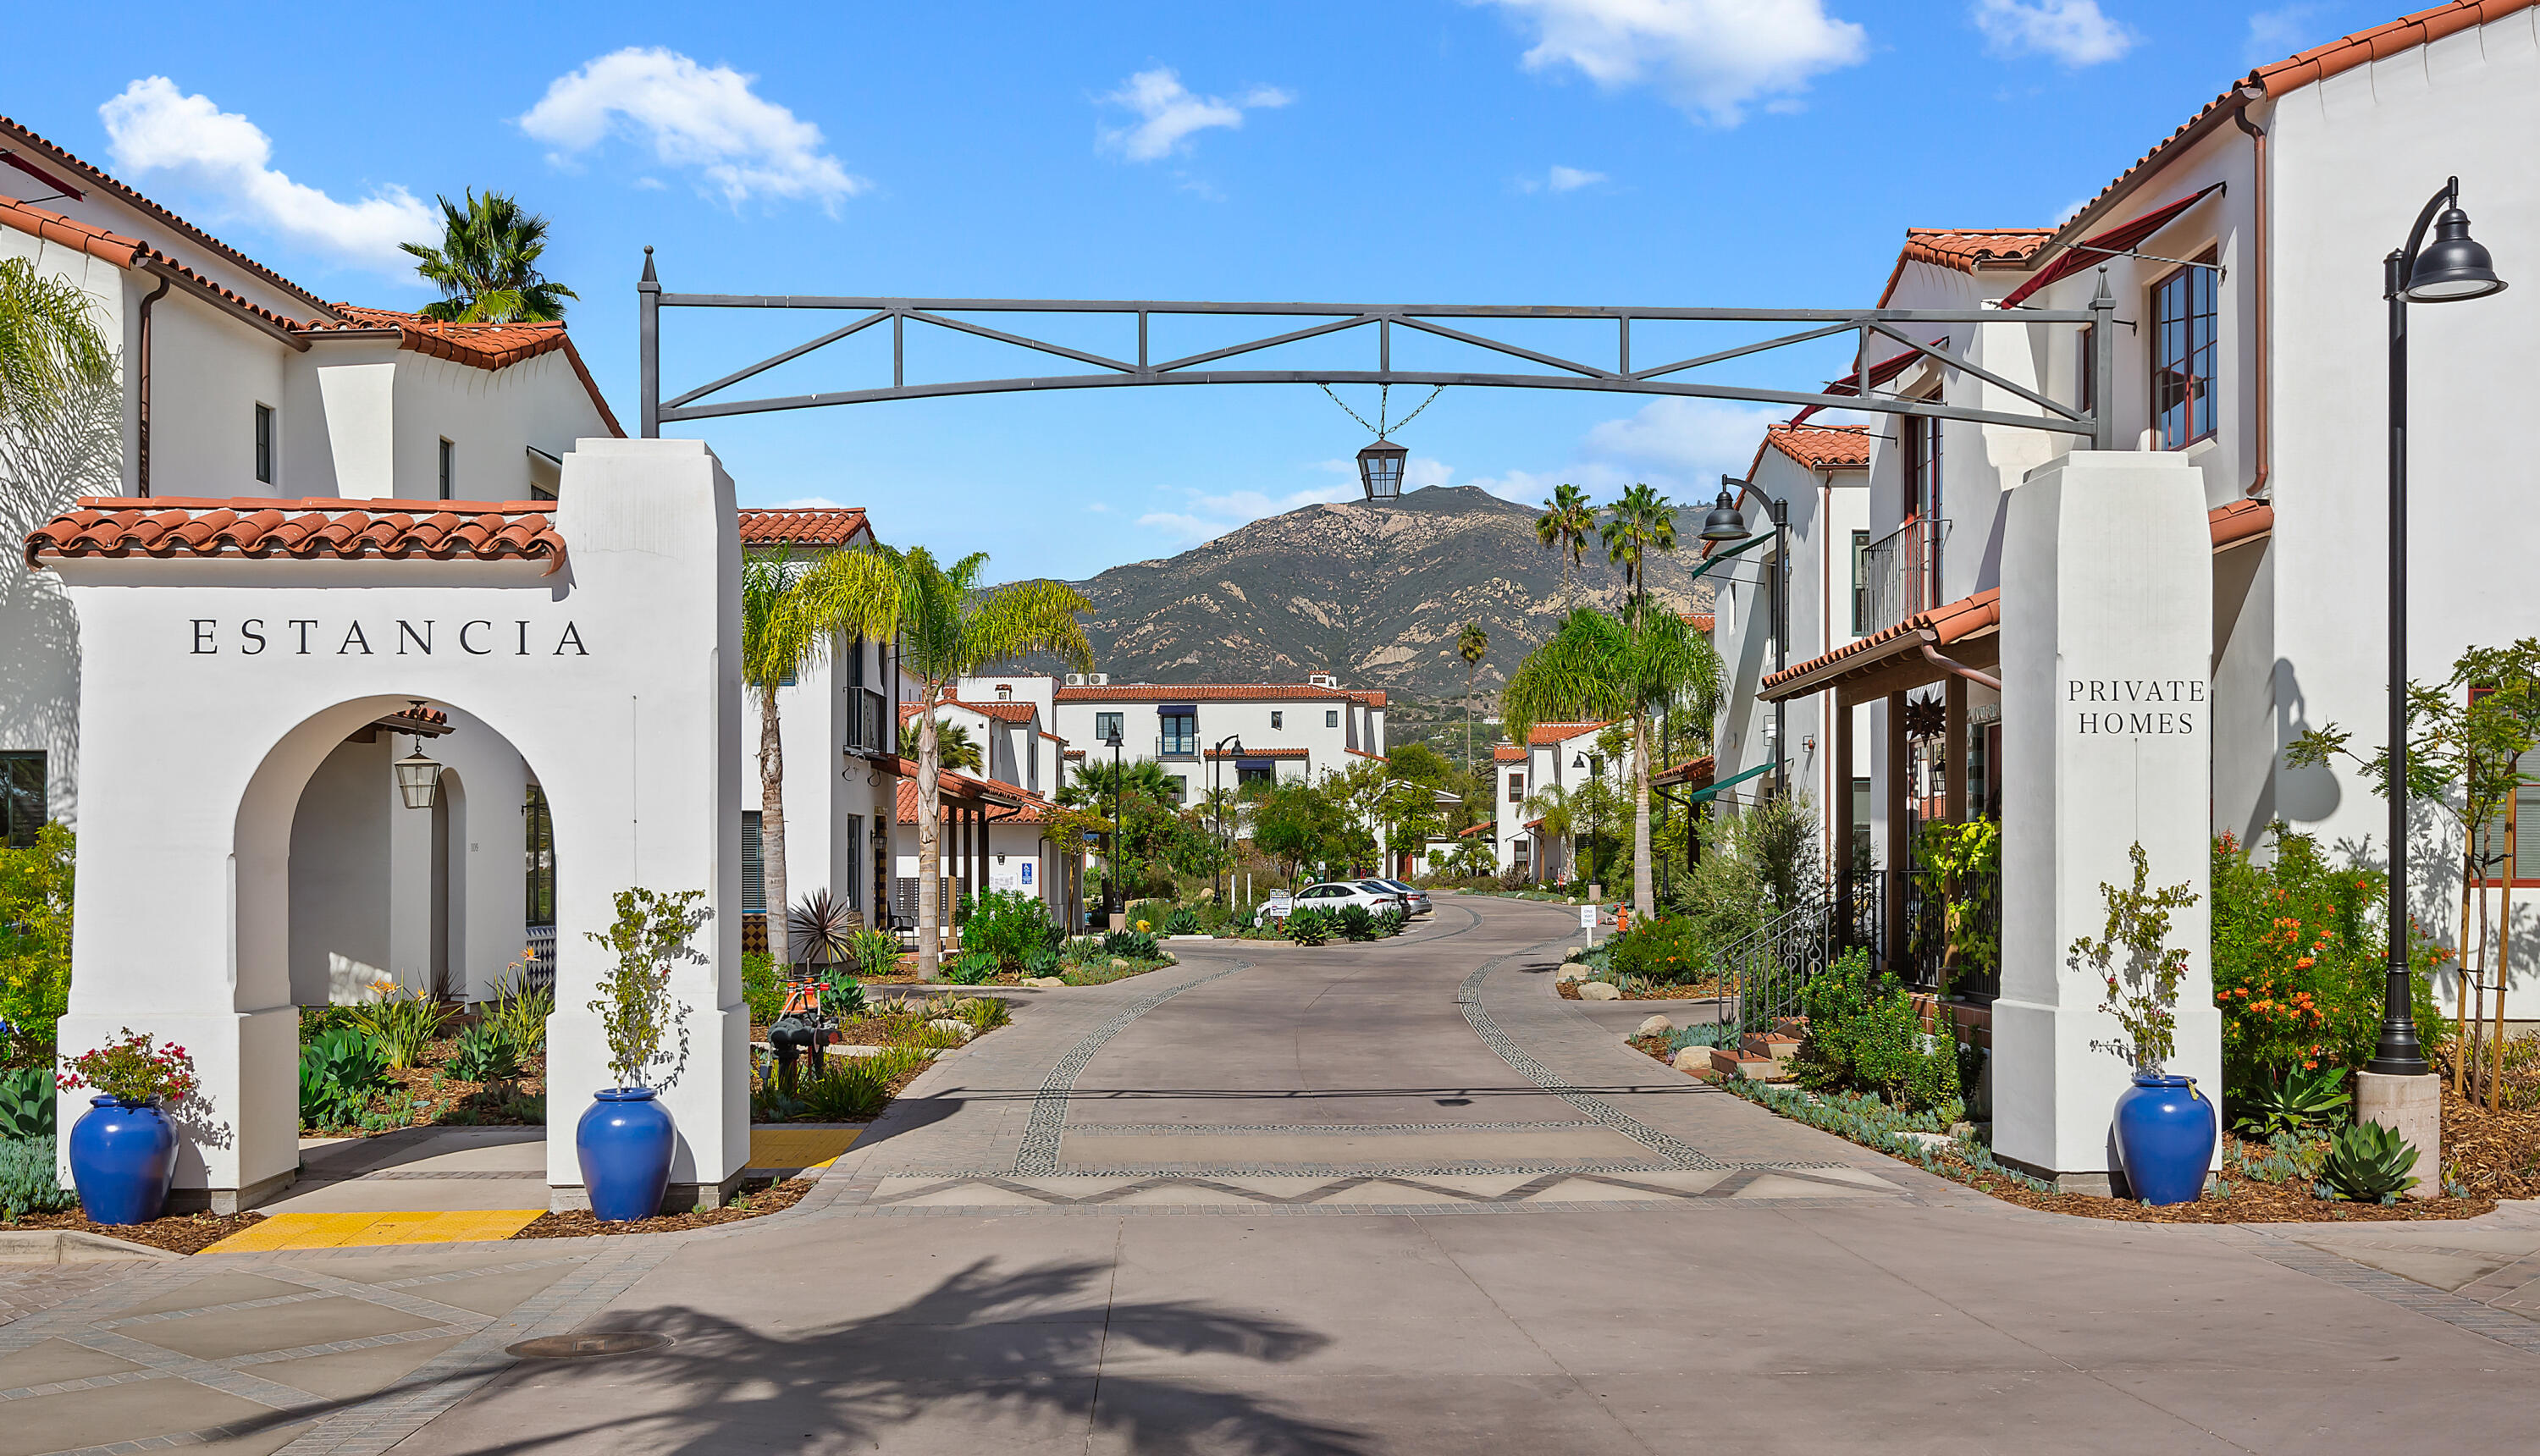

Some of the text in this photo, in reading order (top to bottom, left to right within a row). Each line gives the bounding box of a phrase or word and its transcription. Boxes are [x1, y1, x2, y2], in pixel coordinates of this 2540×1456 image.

[189, 618, 590, 656] ESTANCIA
[2068, 680, 2205, 702] PRIVATE
[2079, 712, 2194, 735] HOMES
